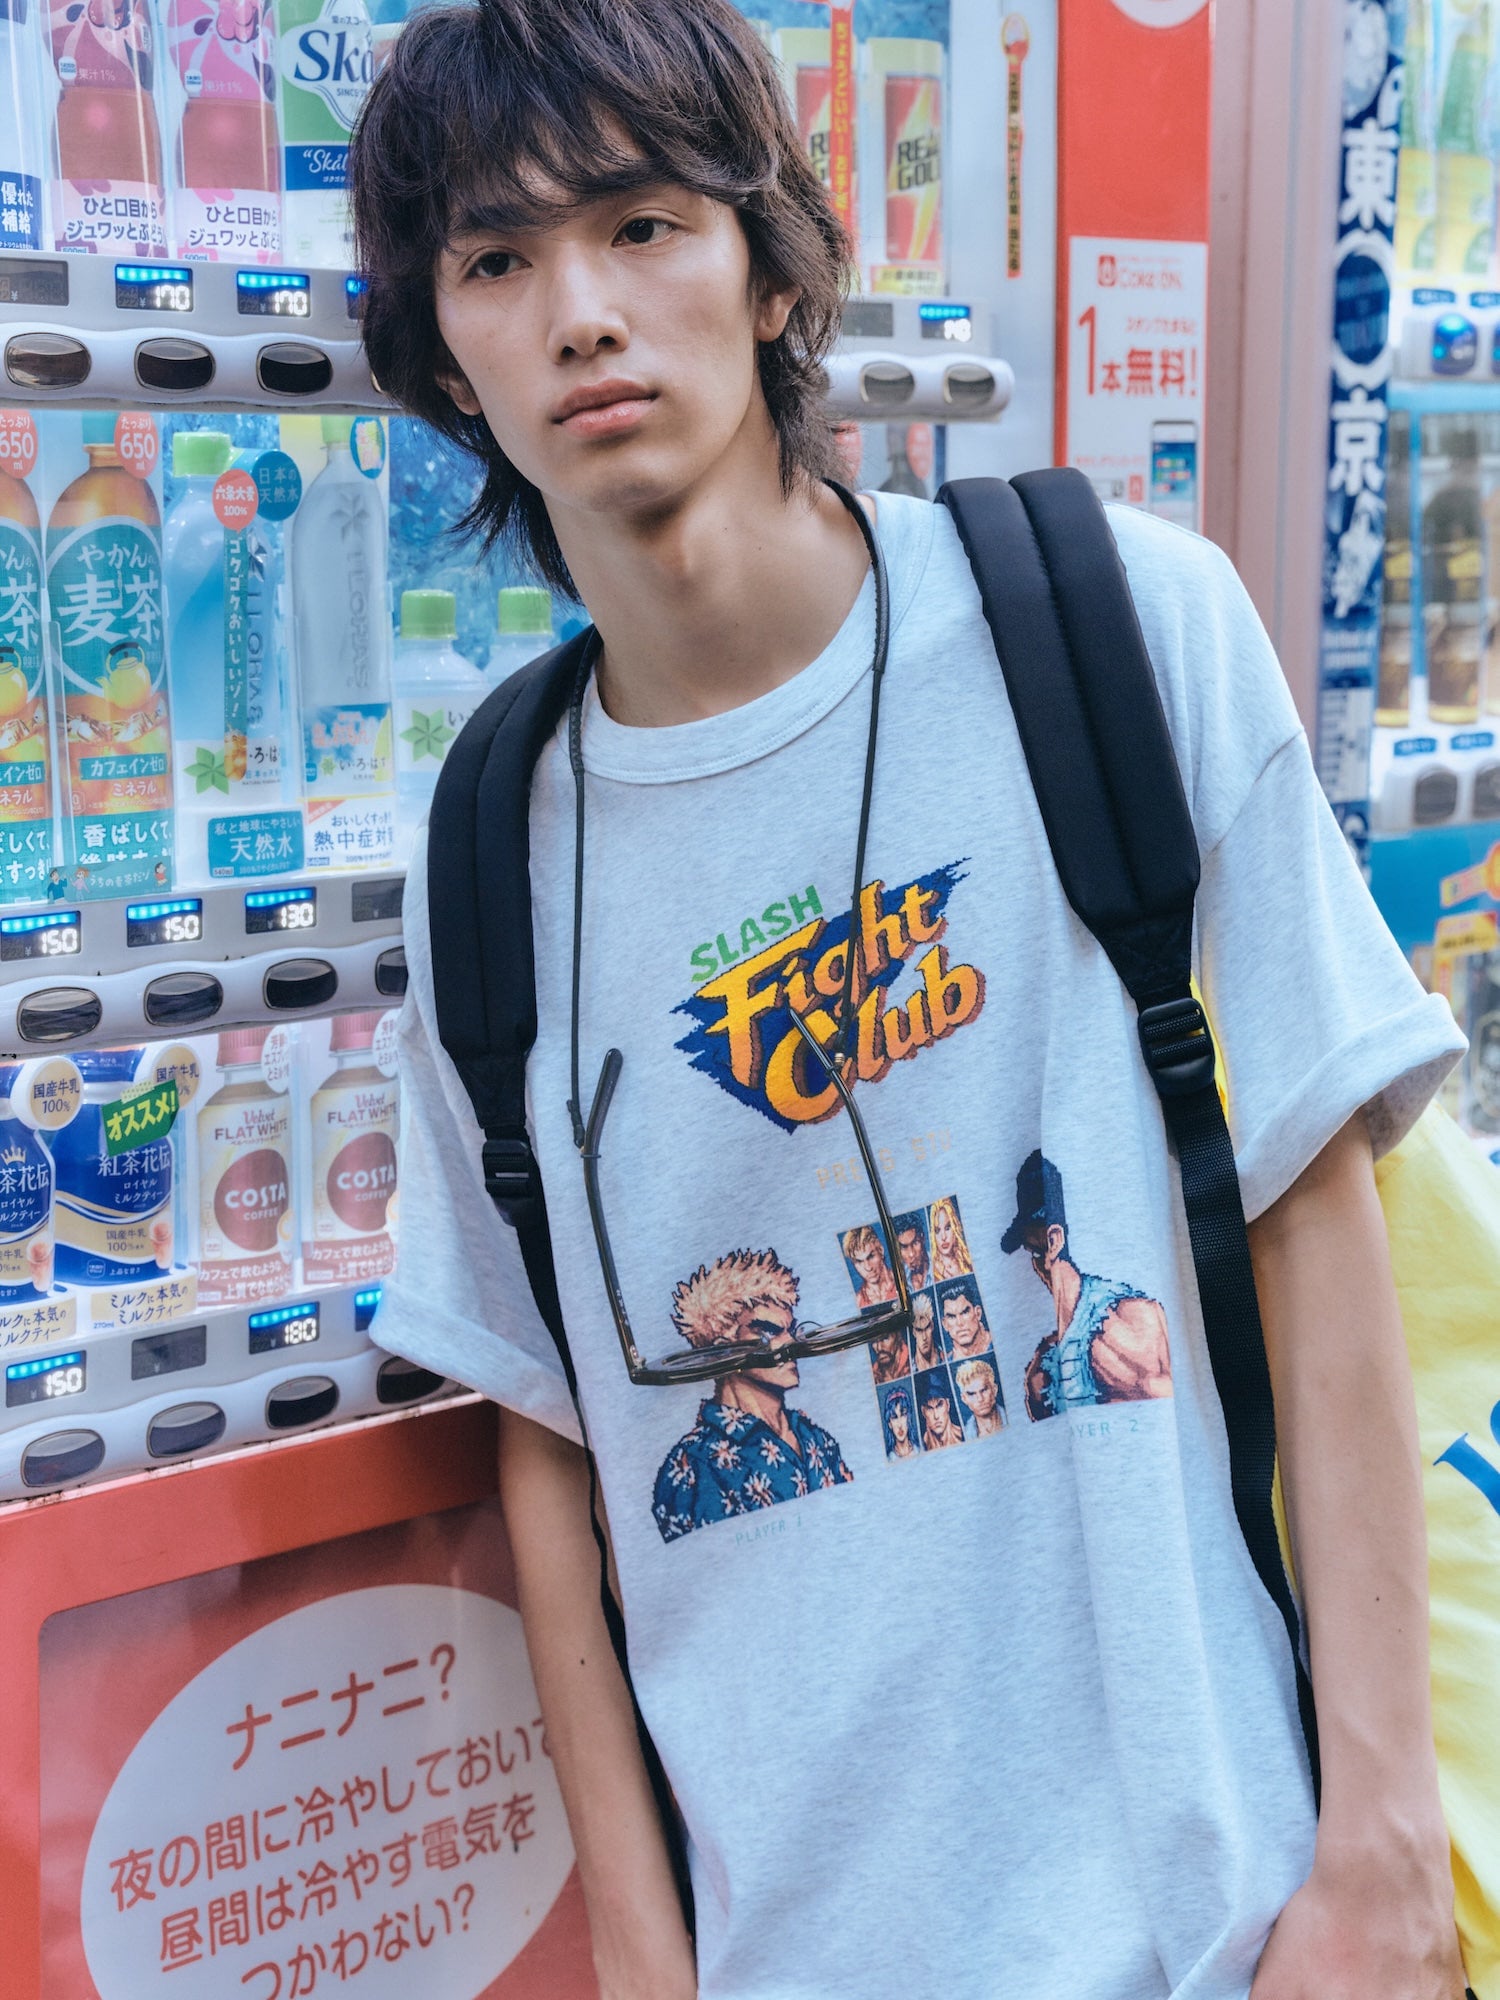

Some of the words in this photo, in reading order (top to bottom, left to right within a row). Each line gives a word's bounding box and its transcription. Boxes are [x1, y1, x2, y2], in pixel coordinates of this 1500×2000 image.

[1, 181, 33, 207] 優れた
[83, 197, 158, 220] ひと口目から
[205, 206, 278, 227] ひと口目から
[2, 208, 31, 234] 補給
[155, 285, 190, 311] 170
[274, 291, 308, 316] 170
[121, 416, 151, 430] たっぷり
[0, 432, 34, 459] 650
[120, 432, 155, 460] 650
[259, 466, 297, 485] 日本の
[215, 484, 255, 501] 六条大麦
[259, 485, 299, 504] 天然水
[223, 505, 247, 516] 100%
[56, 570, 162, 646] 麦茶
[91, 758, 165, 778] カフェインゼロ
[112, 781, 157, 798] ミネラル
[214, 815, 300, 836] 私と地球にやさしい
[230, 830, 294, 863] 天然水
[164, 915, 200, 941] 150
[278, 903, 314, 929] 130
[40, 928, 78, 954] 150
[690, 885, 824, 983] SLASH
[694, 878, 950, 1090] Fight
[764, 944, 987, 1125] Club
[156, 1063, 199, 1082] 国産牛乳
[33, 1079, 80, 1099] 国産牛乳
[355, 1093, 386, 1109] Velvet
[42, 1099, 71, 1114] 100%
[106, 1090, 177, 1142] オススメ!
[243, 1108, 276, 1125] Velvet
[327, 1109, 366, 1124] FLAT
[368, 1101, 397, 1120] WHITE
[214, 1125, 255, 1141] FLAT
[257, 1117, 288, 1136] WHITE
[97, 1145, 171, 1177] 紅茶花伝
[815, 1148, 895, 1190] PRES
[123, 1178, 157, 1190] ロイヤル
[337, 1164, 396, 1191] COSTA
[1, 1197, 35, 1210] ロイヤル
[115, 1191, 163, 1204] ミルクティー
[224, 1182, 287, 1209] COSTA
[354, 1189, 388, 1203] COFFEE
[243, 1208, 279, 1222] COFFEE
[106, 1230, 147, 1241] 国産牛乳
[110, 1283, 188, 1309] ミルクに本気の
[93, 1322, 115, 1330] 270ml
[119, 1303, 184, 1326] ミルクティー
[284, 1318, 316, 1345] 180
[44, 1367, 83, 1397] 150
[1129, 1419, 1139, 1432] 2
[735, 1519, 785, 1546] PLAYER
[797, 1515, 802, 1528] 1
[226, 1643, 457, 1771] ナニナニ?
[159, 1791, 536, 1973] 昼間は冷やす電気を
[241, 1882, 476, 2000] つかわない?
